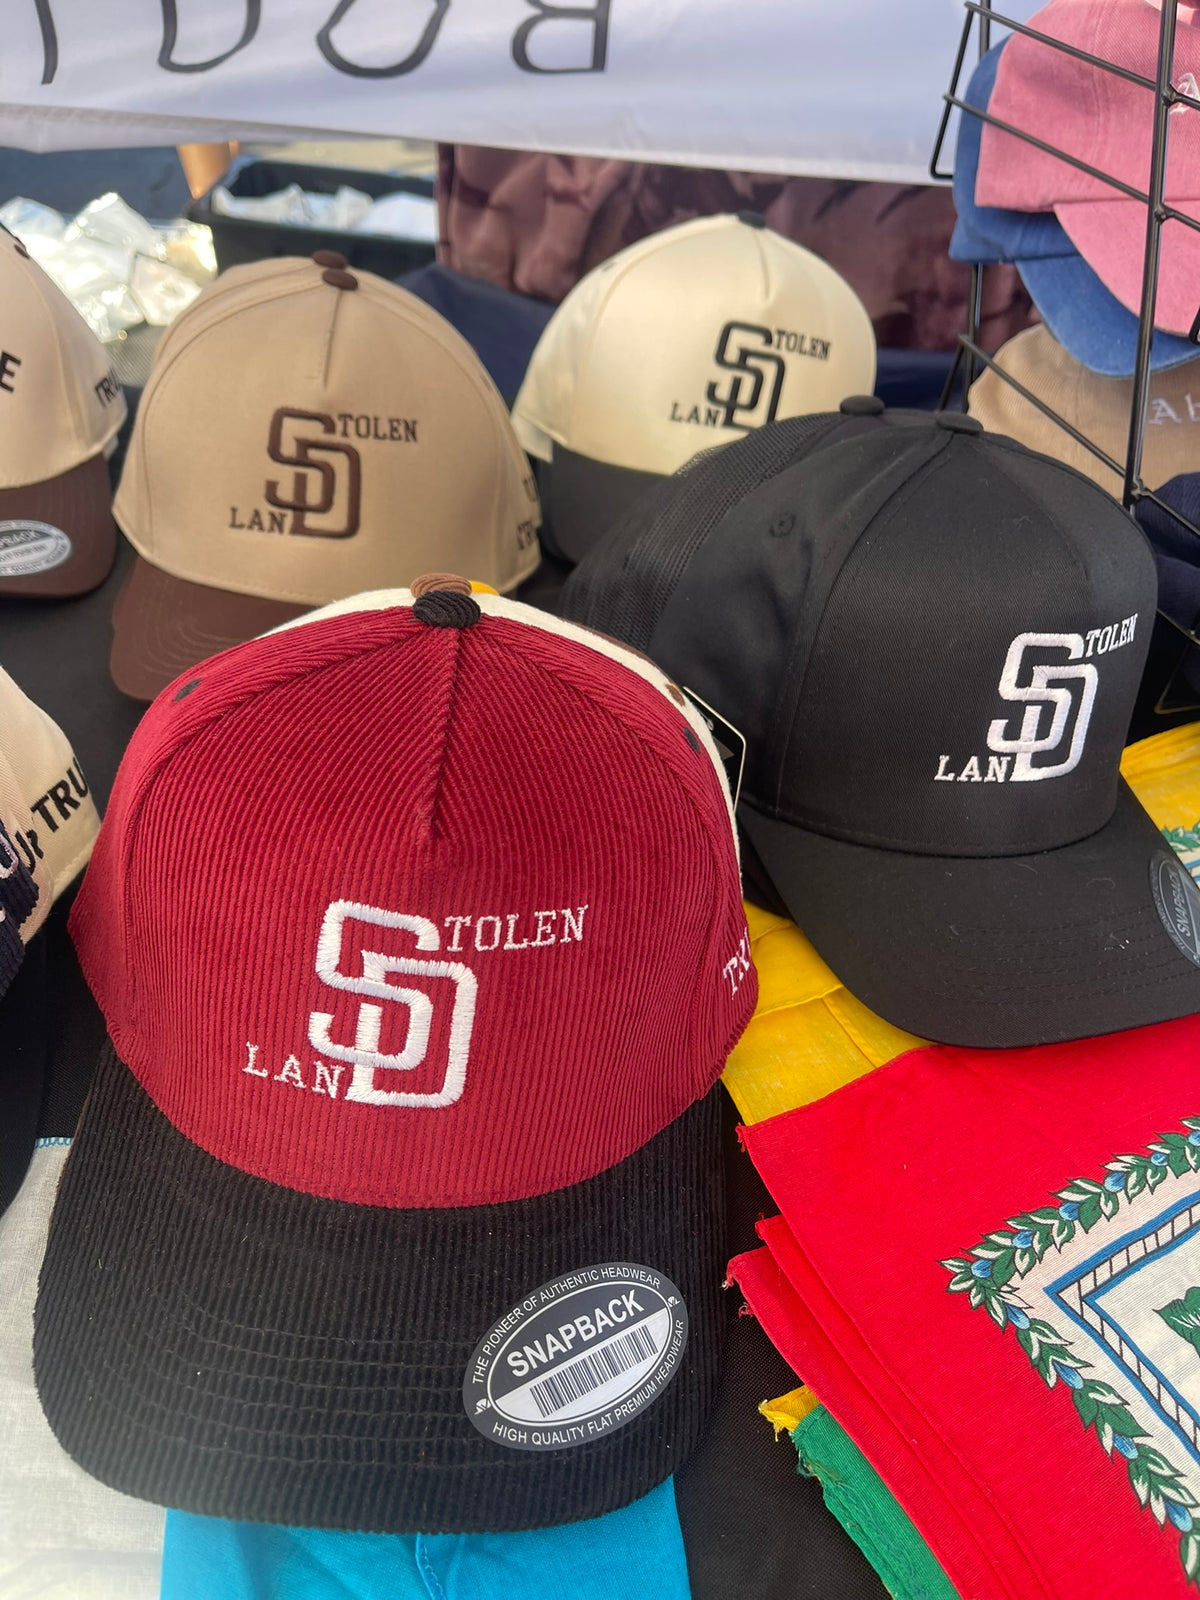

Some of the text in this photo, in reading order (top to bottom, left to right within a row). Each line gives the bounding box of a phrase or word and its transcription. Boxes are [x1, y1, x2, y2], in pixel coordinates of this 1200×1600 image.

[472, 1267, 661, 1384] THE PIONEER OF AUTHENTIC HEADWEAR
[492, 1319, 684, 1445] HIGH QUALITY FLAT PREMIUM HEADWEAR
[507, 1289, 645, 1377] SNAPBACK
